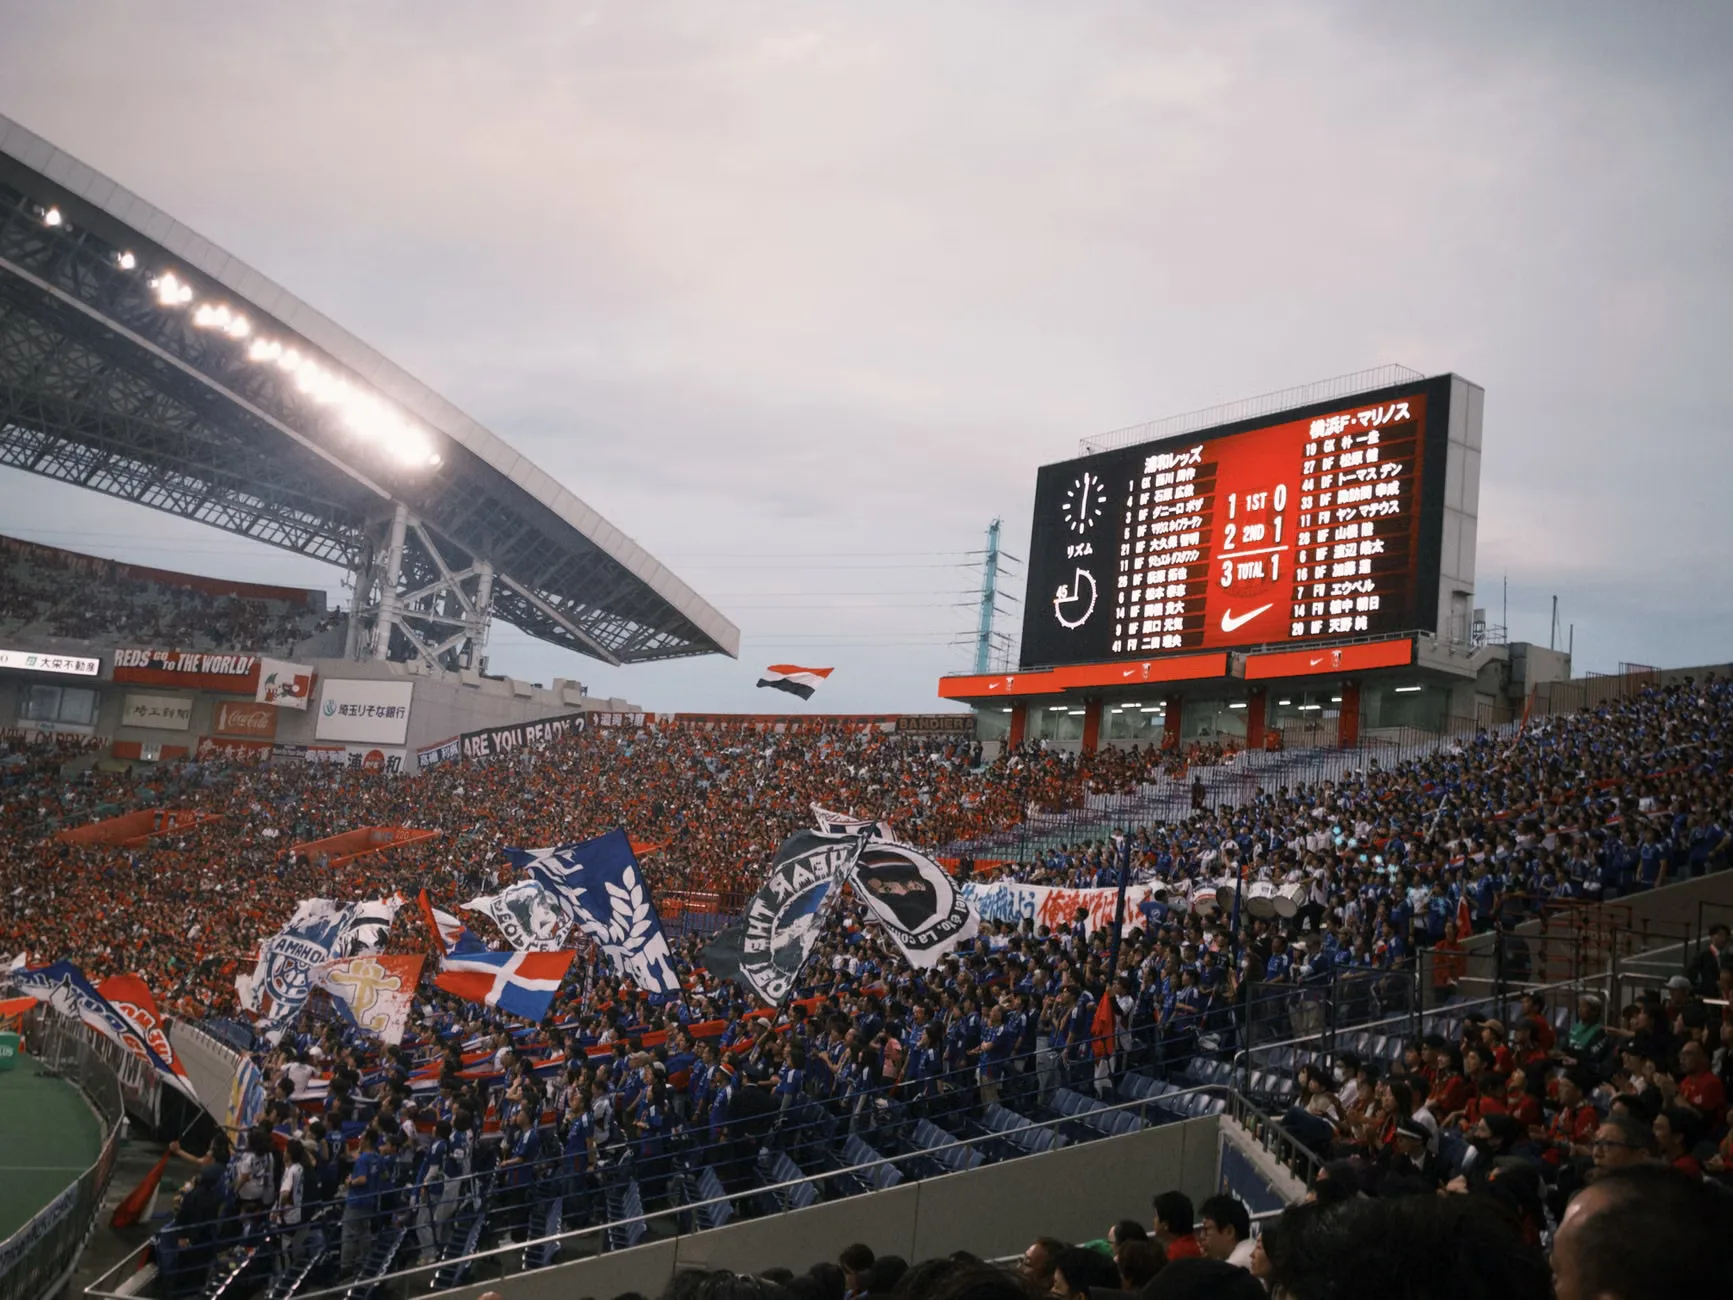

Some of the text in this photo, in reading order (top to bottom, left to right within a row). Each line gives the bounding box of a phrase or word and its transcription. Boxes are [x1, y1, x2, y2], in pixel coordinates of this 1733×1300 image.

[1306, 443, 1316, 456] 19
[1304, 460, 1316, 474] 27
[1129, 480, 1133, 492] 1
[1302, 478, 1314, 492] 44
[1338, 467, 1377, 486] トーマス
[1127, 496, 1133, 507] 4
[1228, 484, 1287, 519] 1 1ST 0
[1301, 496, 1313, 510] 33
[1301, 514, 1310, 527] 11
[1124, 527, 1130, 539] 5
[1223, 516, 1282, 550] 2 2ND 1
[1121, 544, 1130, 555] 21
[1120, 560, 1128, 572] 11
[1220, 554, 1279, 587] 3 TOTAL 1
[1297, 568, 1308, 581] 16
[1298, 586, 1304, 600] 7
[1116, 607, 1125, 619] 14
[1294, 604, 1305, 618] 14
[1292, 622, 1304, 636] 20
[1112, 640, 1121, 652] 41
[114, 648, 255, 675] REDS GO TO THE WORLD!
[339, 704, 406, 719] 埼玉りそな銀行
[463, 733, 490, 757] ARE
[492, 729, 522, 752] YOU
